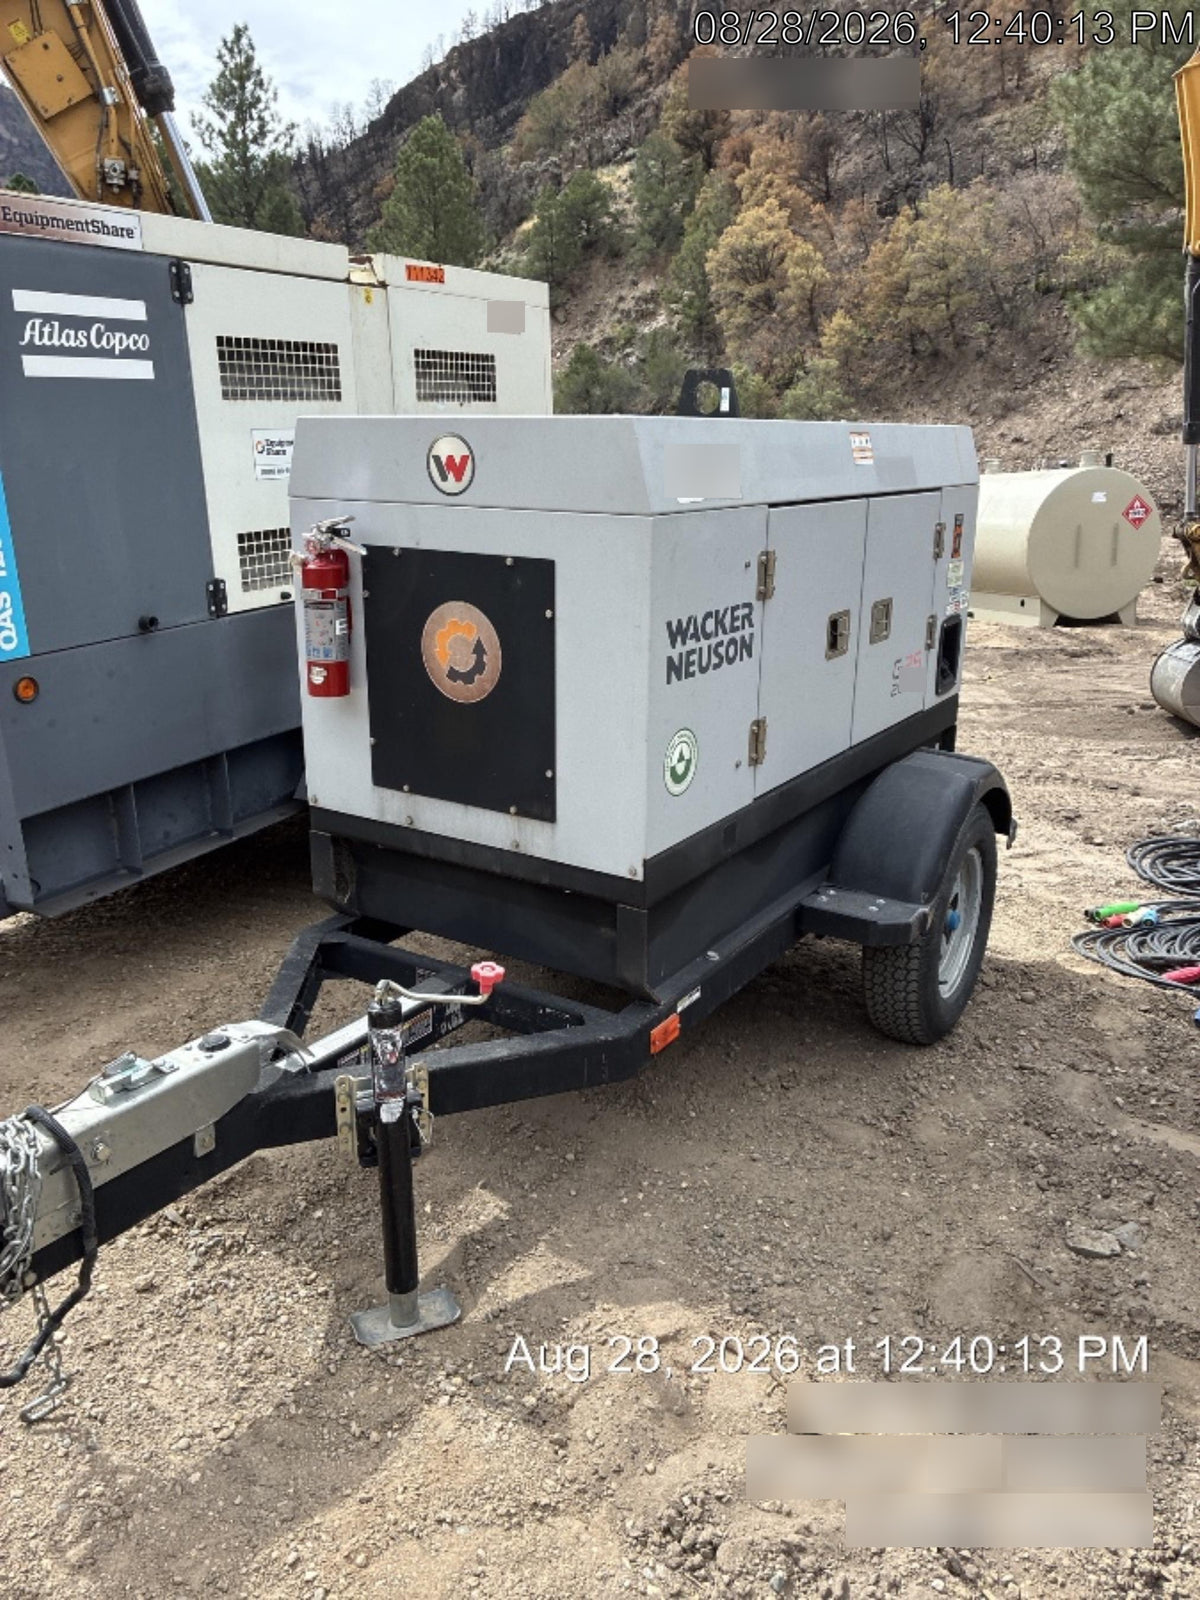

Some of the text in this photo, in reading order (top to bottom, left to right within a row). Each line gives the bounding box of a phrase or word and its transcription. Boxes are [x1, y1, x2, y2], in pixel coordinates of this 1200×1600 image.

[1, 205, 135, 239] EquipmentShare
[19, 318, 150, 356] Atlas Copco
[665, 602, 755, 650] WACKER
[665, 633, 755, 685] NEUSON
